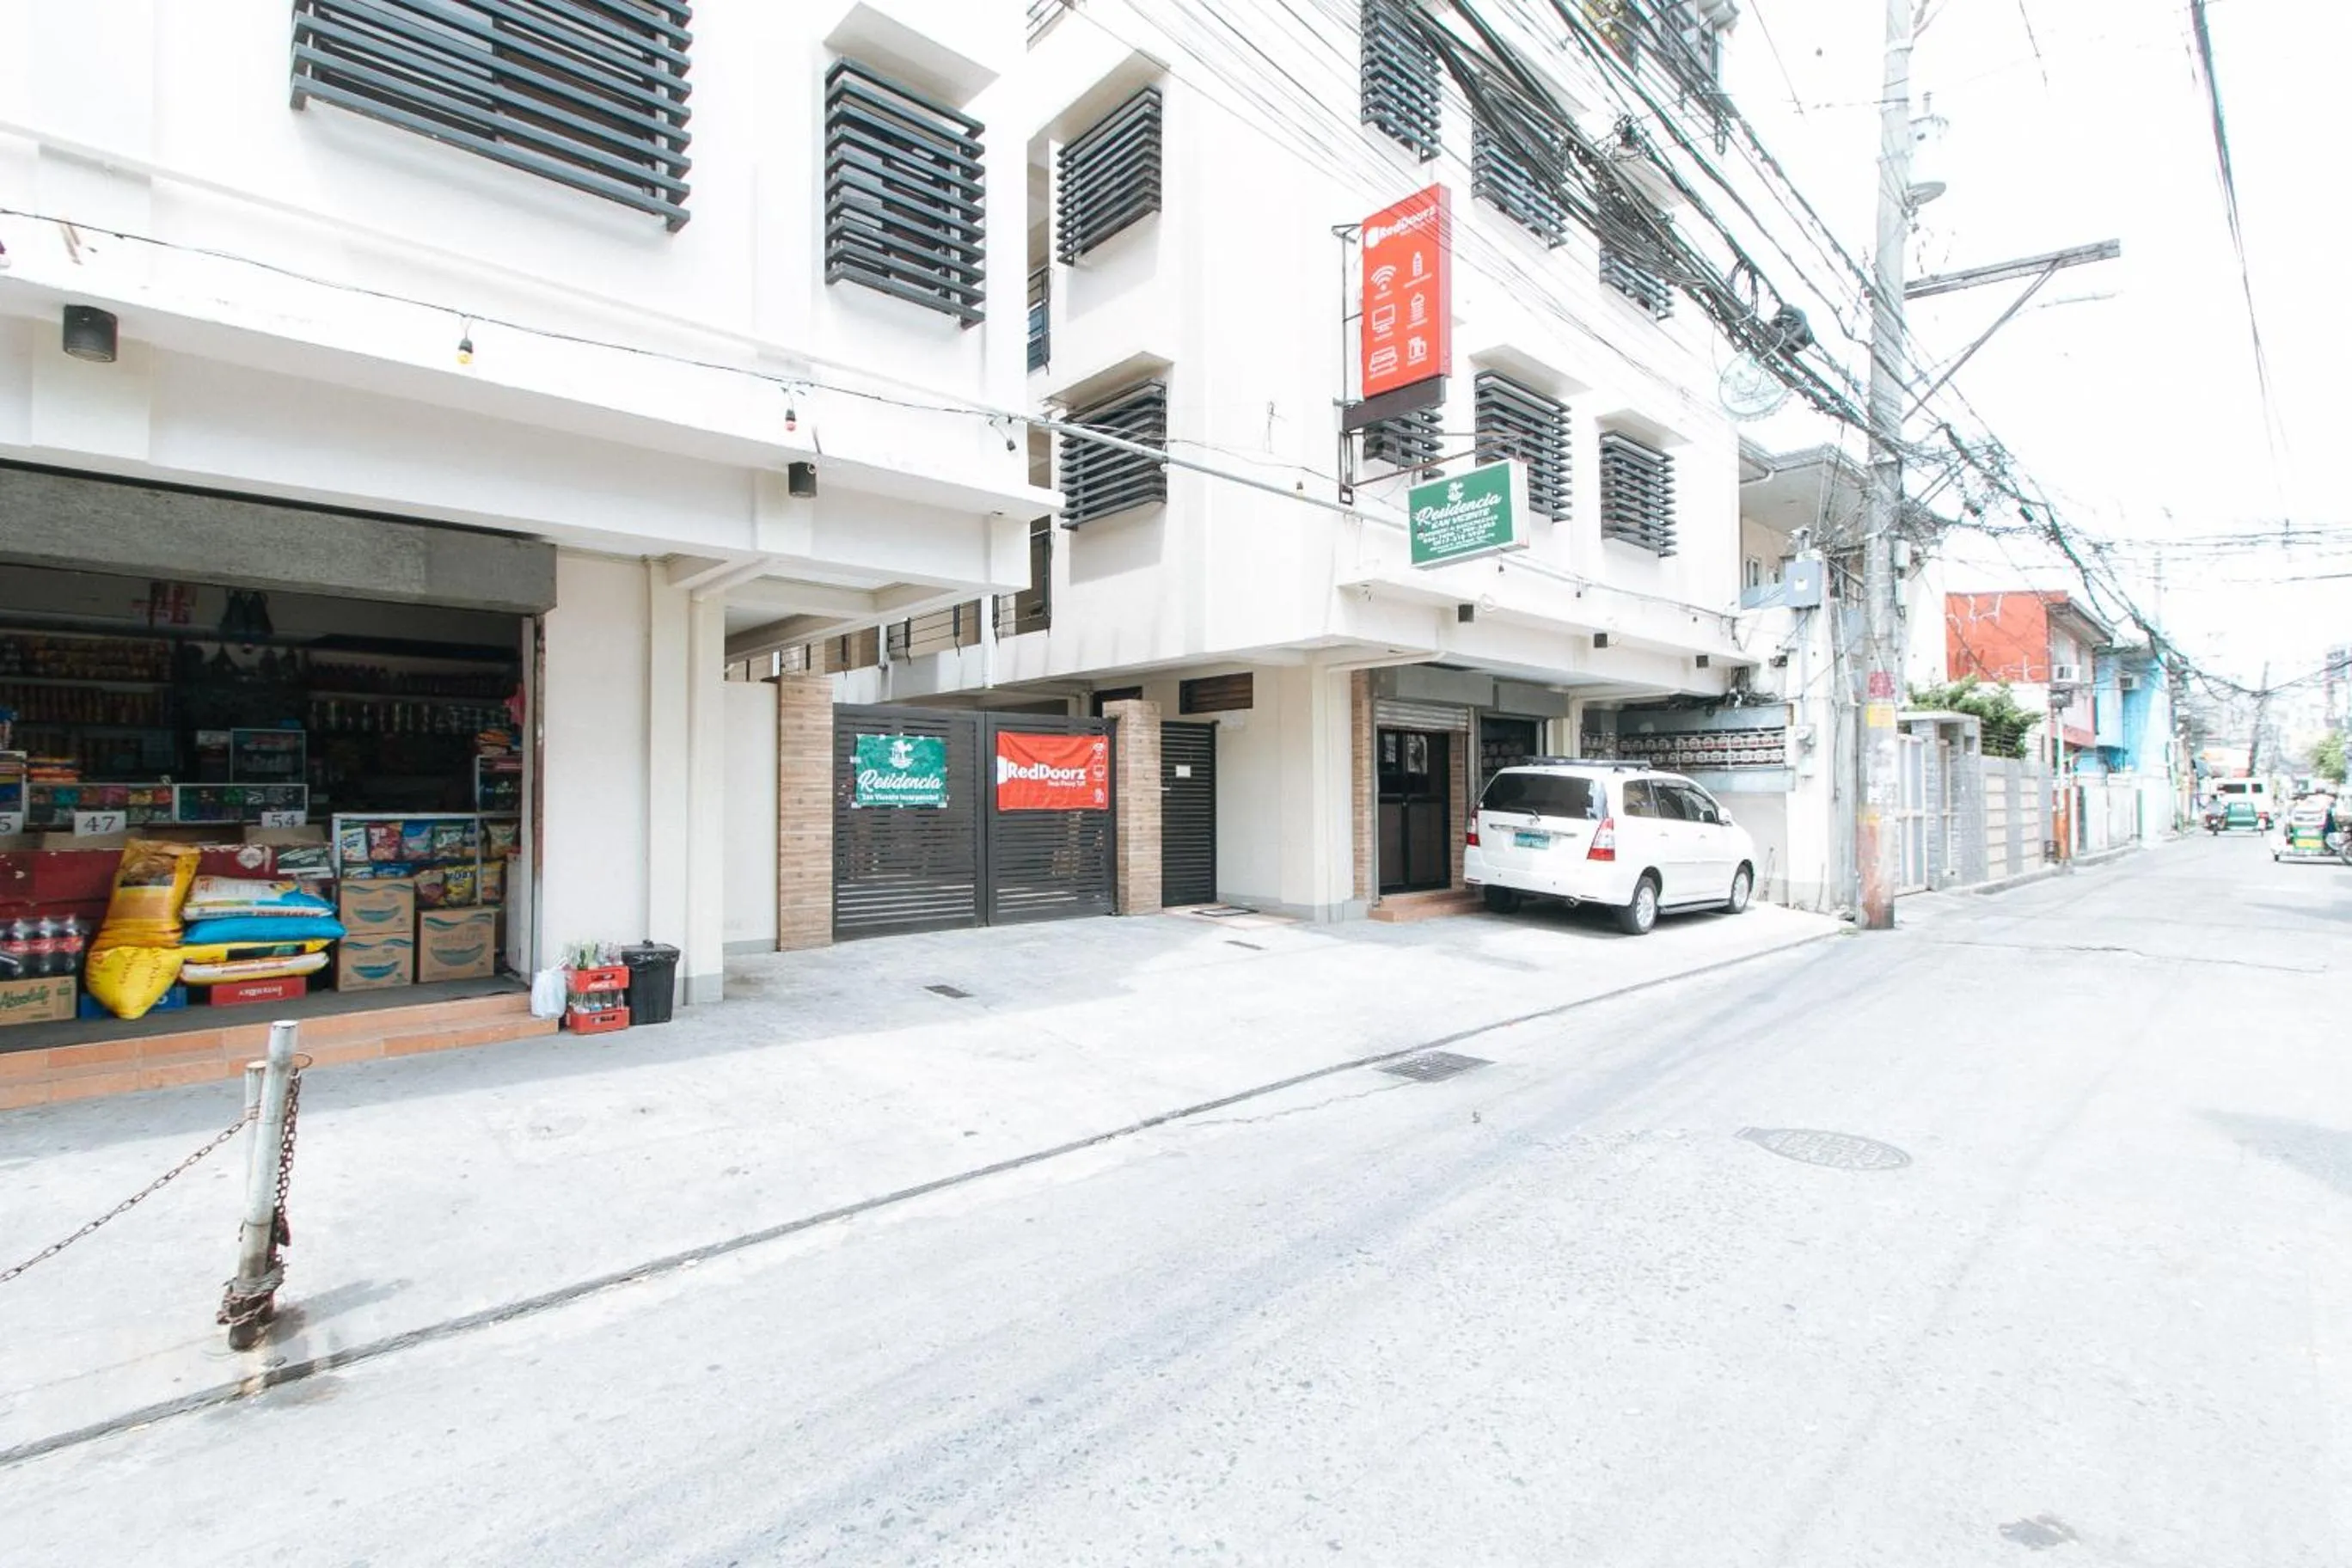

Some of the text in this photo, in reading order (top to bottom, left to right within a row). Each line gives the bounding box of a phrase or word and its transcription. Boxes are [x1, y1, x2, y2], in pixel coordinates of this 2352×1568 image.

[1412, 492, 1503, 526] Residencia
[857, 769, 944, 793] Residencia
[1008, 761, 1087, 781] RedDoorz
[84, 816, 116, 831] 47
[271, 814, 296, 828] 54
